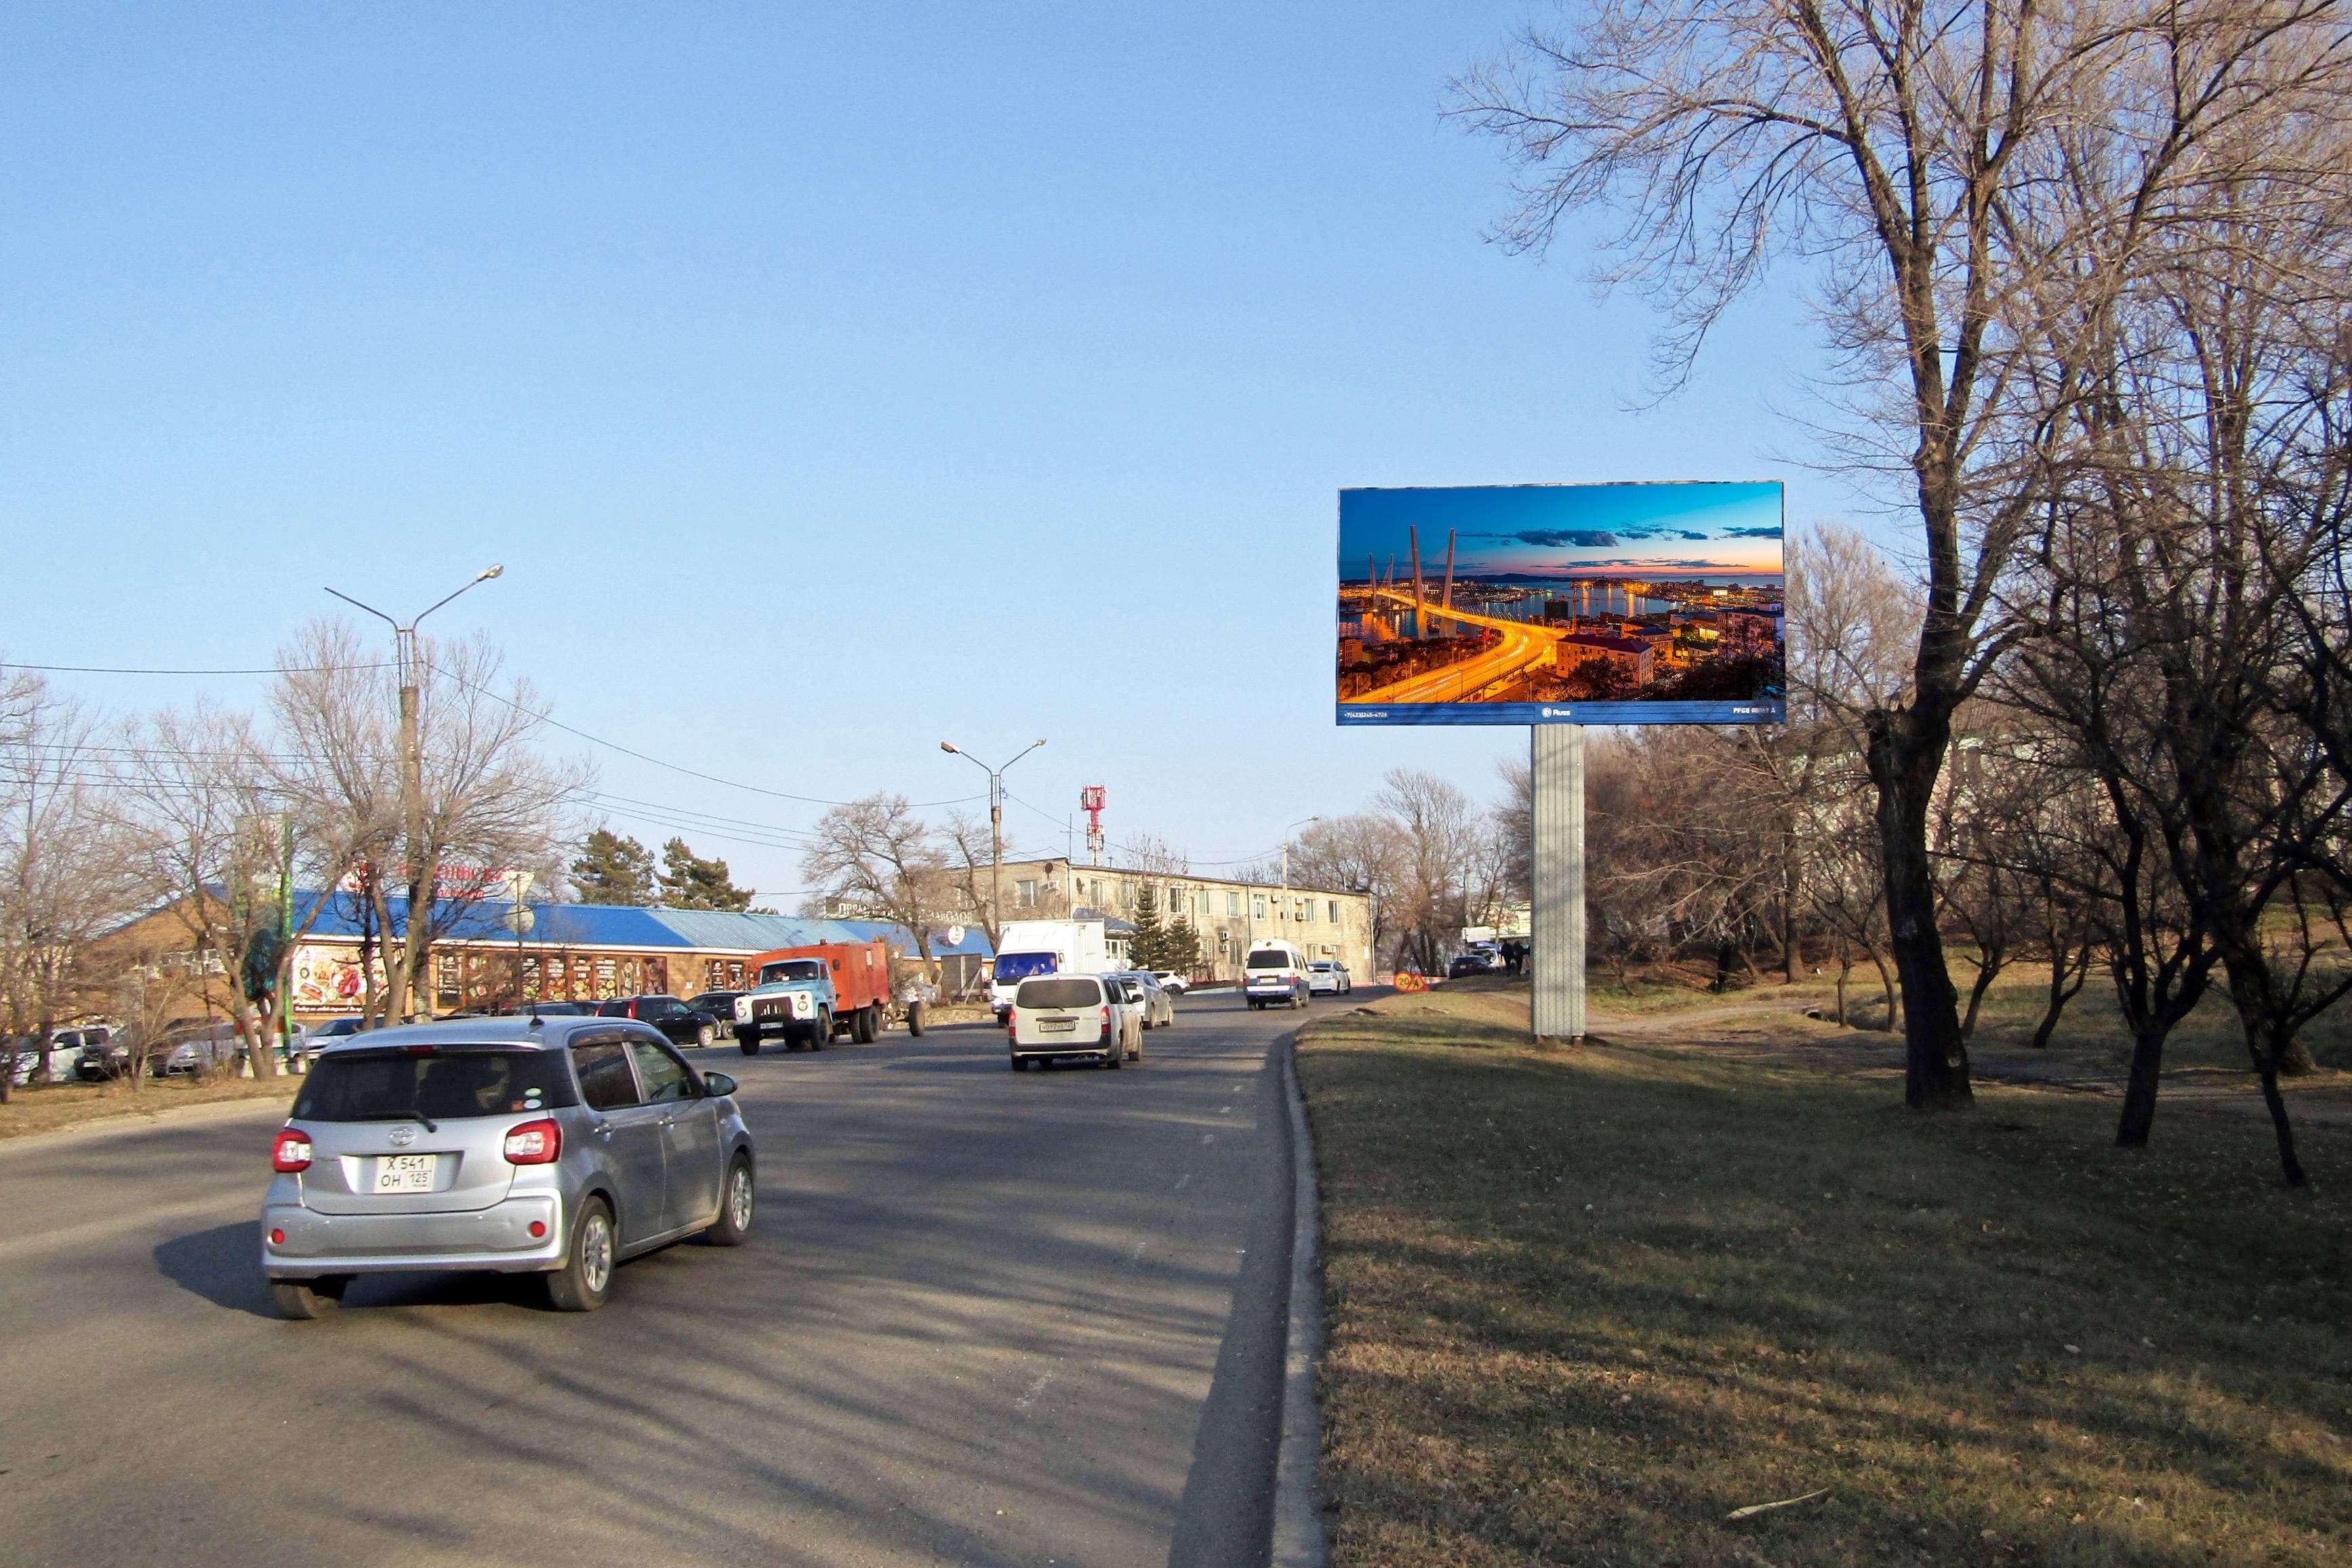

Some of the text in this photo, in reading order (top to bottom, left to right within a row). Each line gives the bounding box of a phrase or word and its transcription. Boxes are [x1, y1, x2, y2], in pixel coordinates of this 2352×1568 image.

[1398, 977, 1409, 986] 20
[401, 1157, 424, 1170] 541
[381, 1173, 428, 1187] ОН 125
